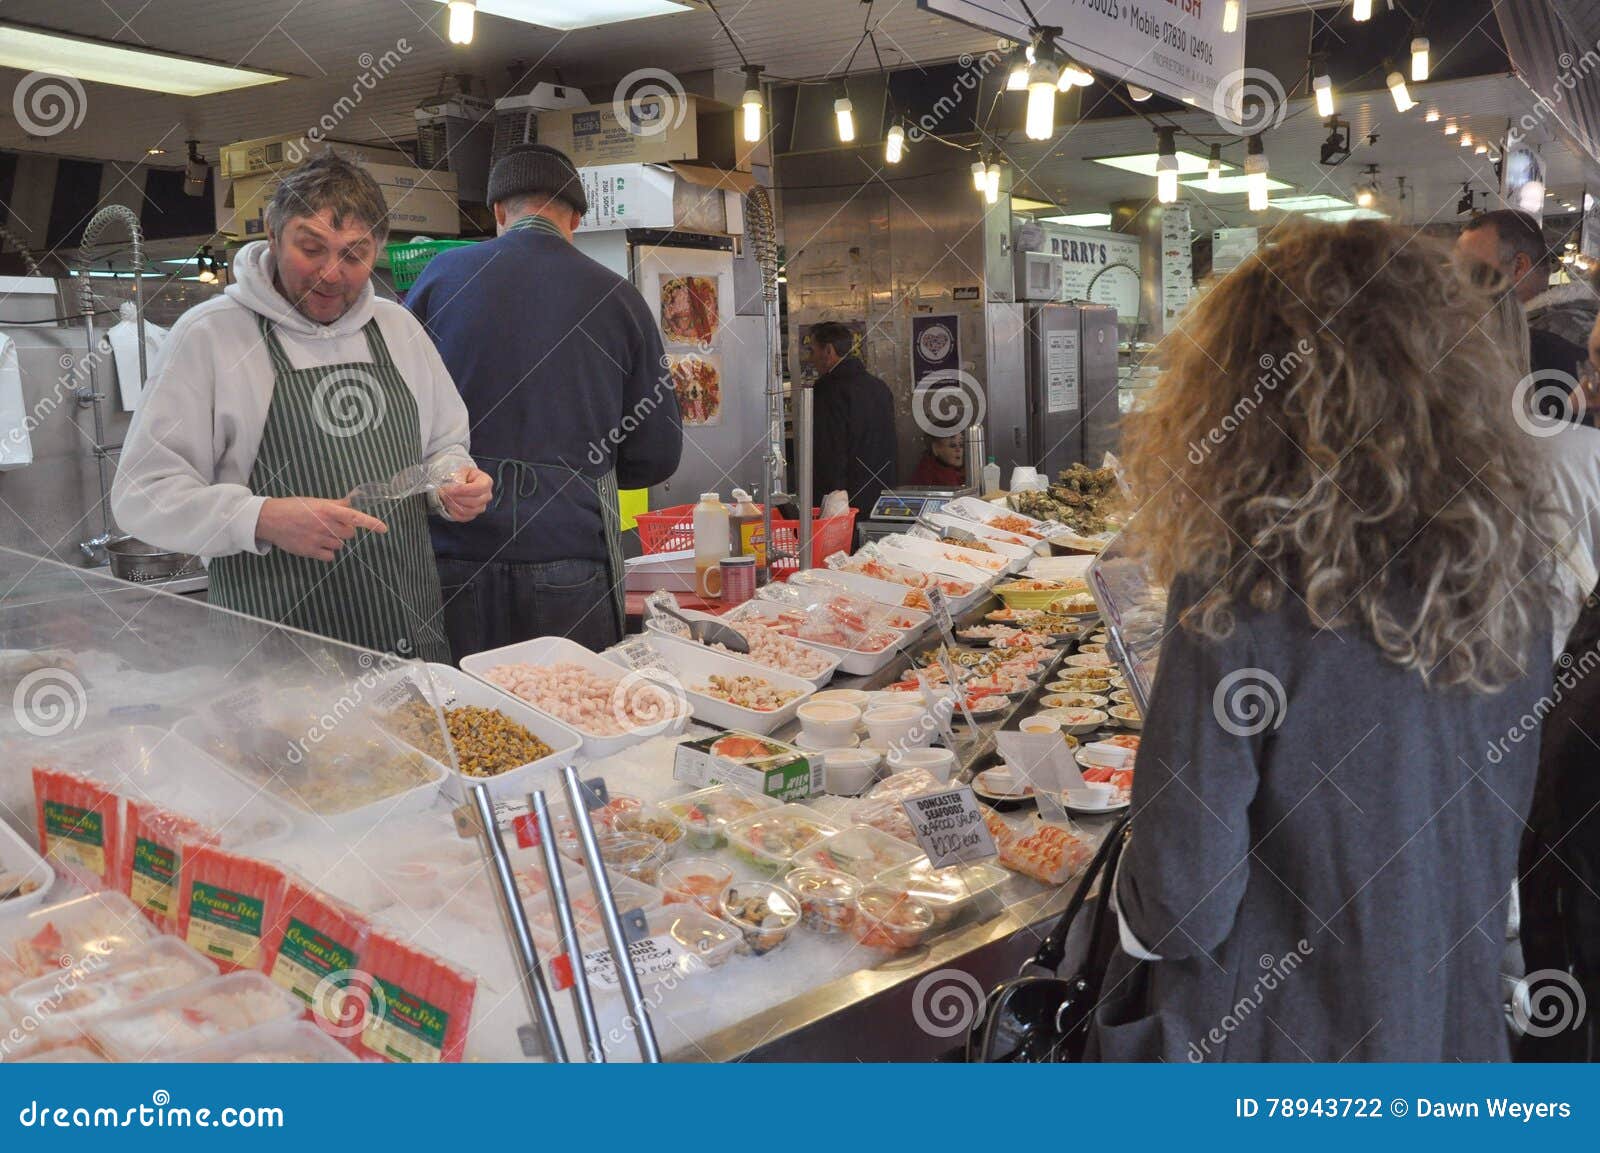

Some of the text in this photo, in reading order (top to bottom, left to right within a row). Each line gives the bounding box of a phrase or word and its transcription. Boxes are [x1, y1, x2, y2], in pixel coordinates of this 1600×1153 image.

[1130, 3, 1160, 39] Mobile
[1163, 21, 1186, 52] 07830
[916, 793, 962, 811] DONCASTER
[925, 804, 965, 820] SEAFOODS
